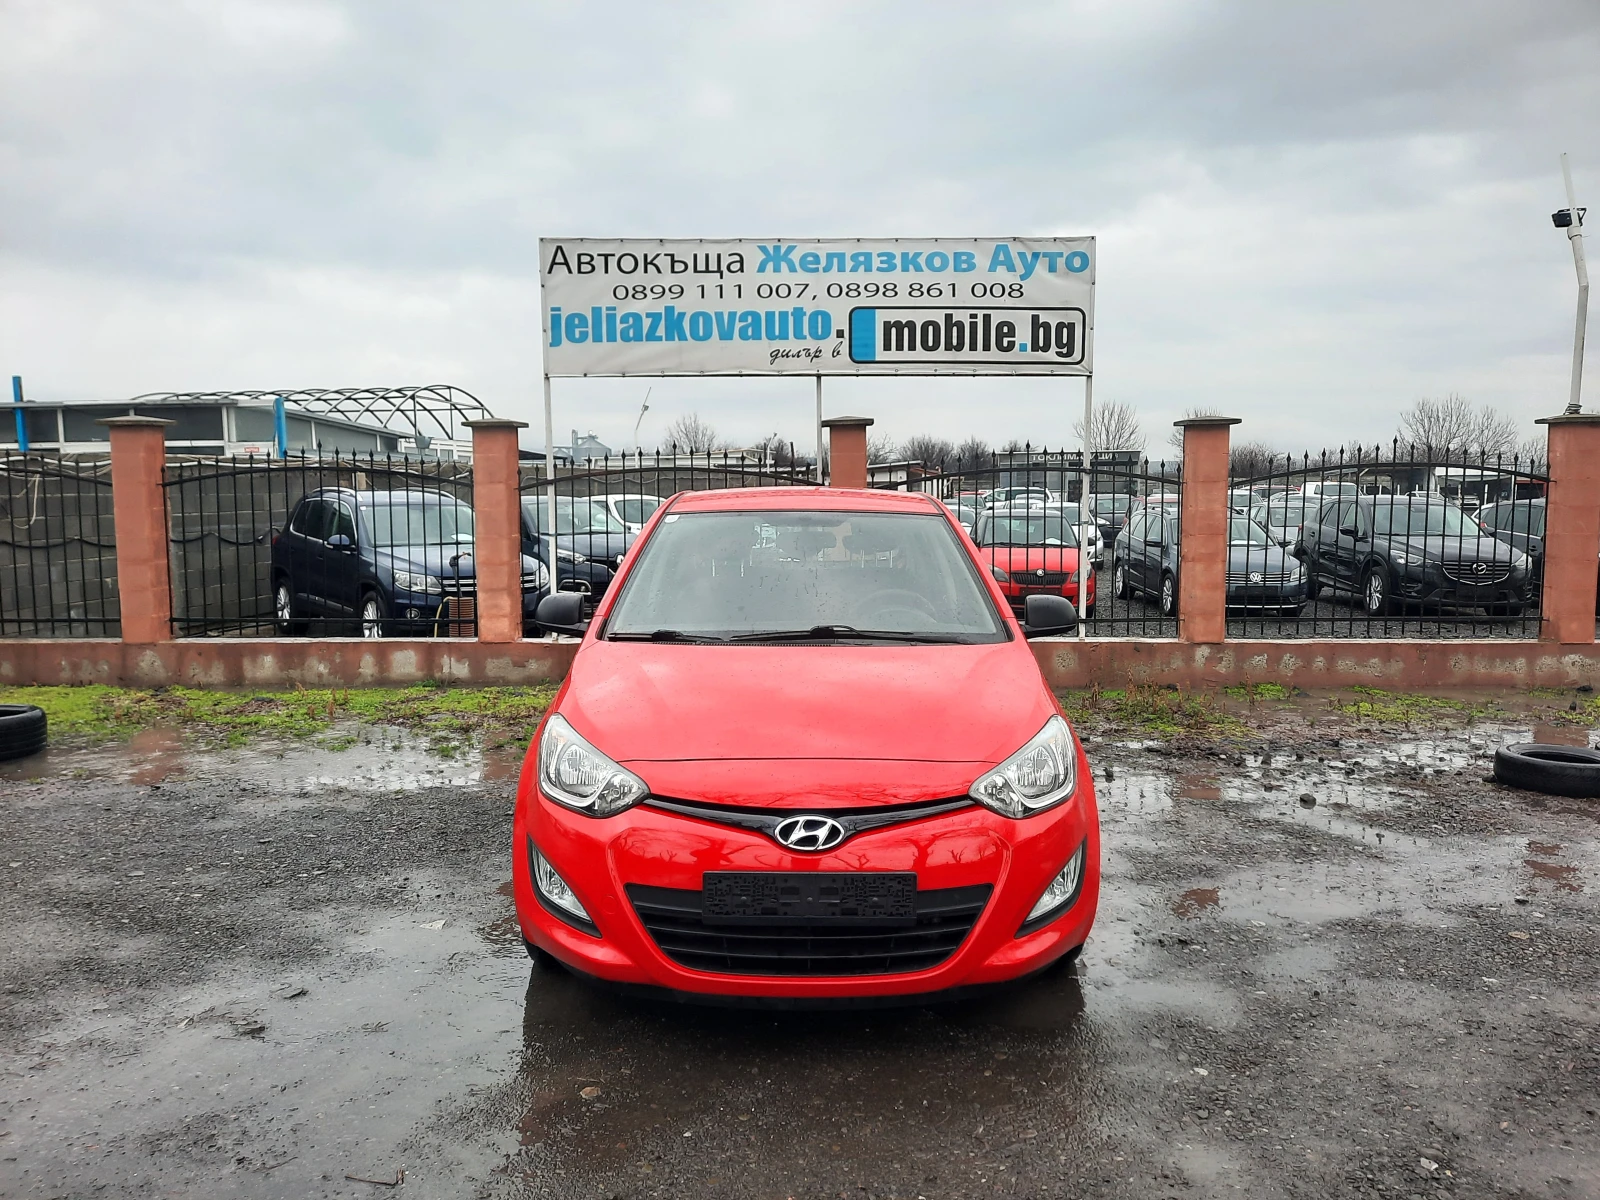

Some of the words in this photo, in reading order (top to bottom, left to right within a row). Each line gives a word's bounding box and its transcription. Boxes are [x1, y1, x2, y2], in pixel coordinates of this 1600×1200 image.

[547, 245, 745, 279] Автокъща
[756, 245, 977, 274] Желязков
[987, 243, 1090, 281] Ауто
[612, 284, 685, 300] 0899
[696, 284, 743, 299] 111
[756, 283, 817, 303] 007,
[826, 282, 898, 299] 0898
[908, 282, 958, 298] 861
[970, 282, 1025, 298] 008
[883, 313, 1076, 358] mobile.bg
[769, 346, 823, 365] дилър
